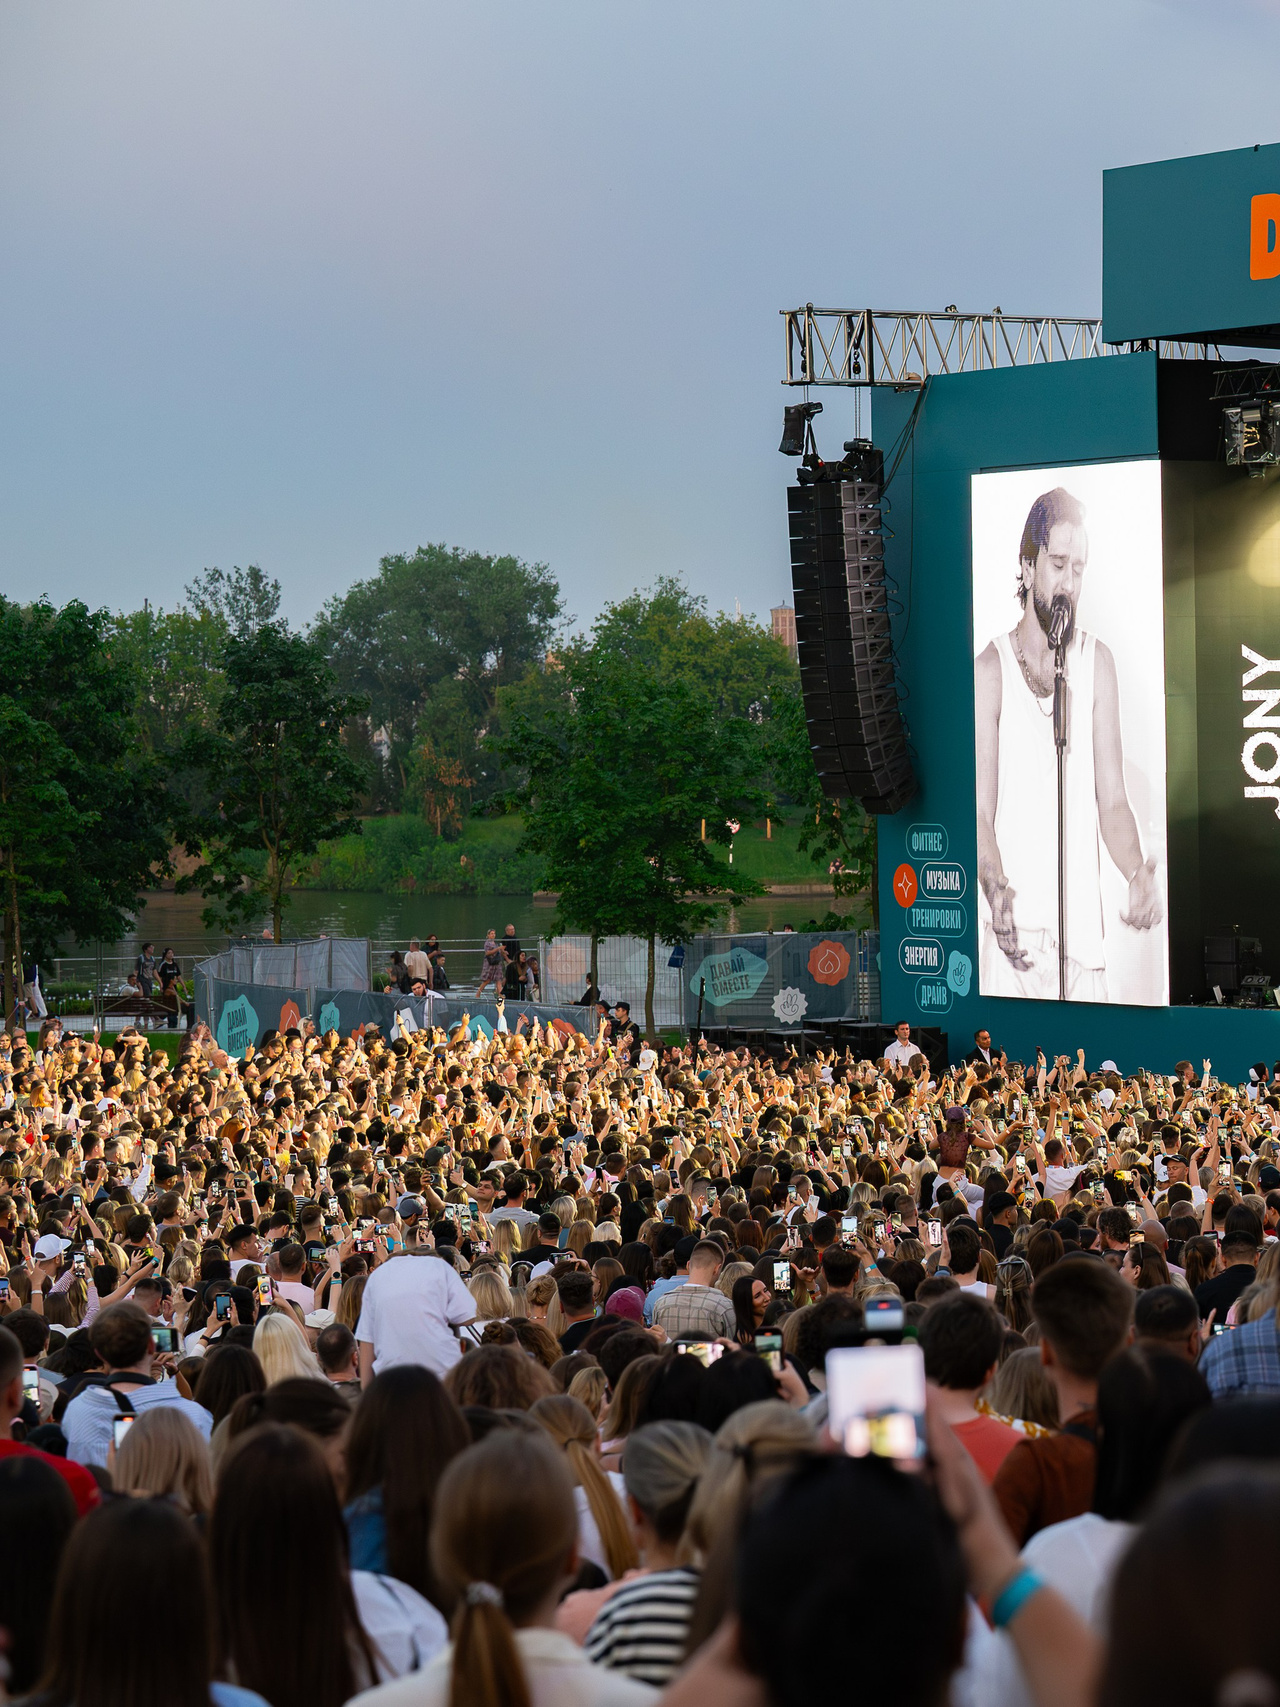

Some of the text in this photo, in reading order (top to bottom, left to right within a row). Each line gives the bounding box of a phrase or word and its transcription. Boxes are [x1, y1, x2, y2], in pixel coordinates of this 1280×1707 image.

[912, 832, 943, 852] ФИТНЕС
[926, 870, 961, 891] МУЗЫКА
[911, 909, 962, 930] ТРЕНИРОВКИ
[904, 946, 938, 967] ЭНЕРГИЯ
[709, 954, 746, 982] ДАВАЙ
[711, 975, 751, 998] ВМЕСТЕ
[921, 982, 947, 1006] ДРАЙВ
[227, 1003, 248, 1033] ДАВАЙ
